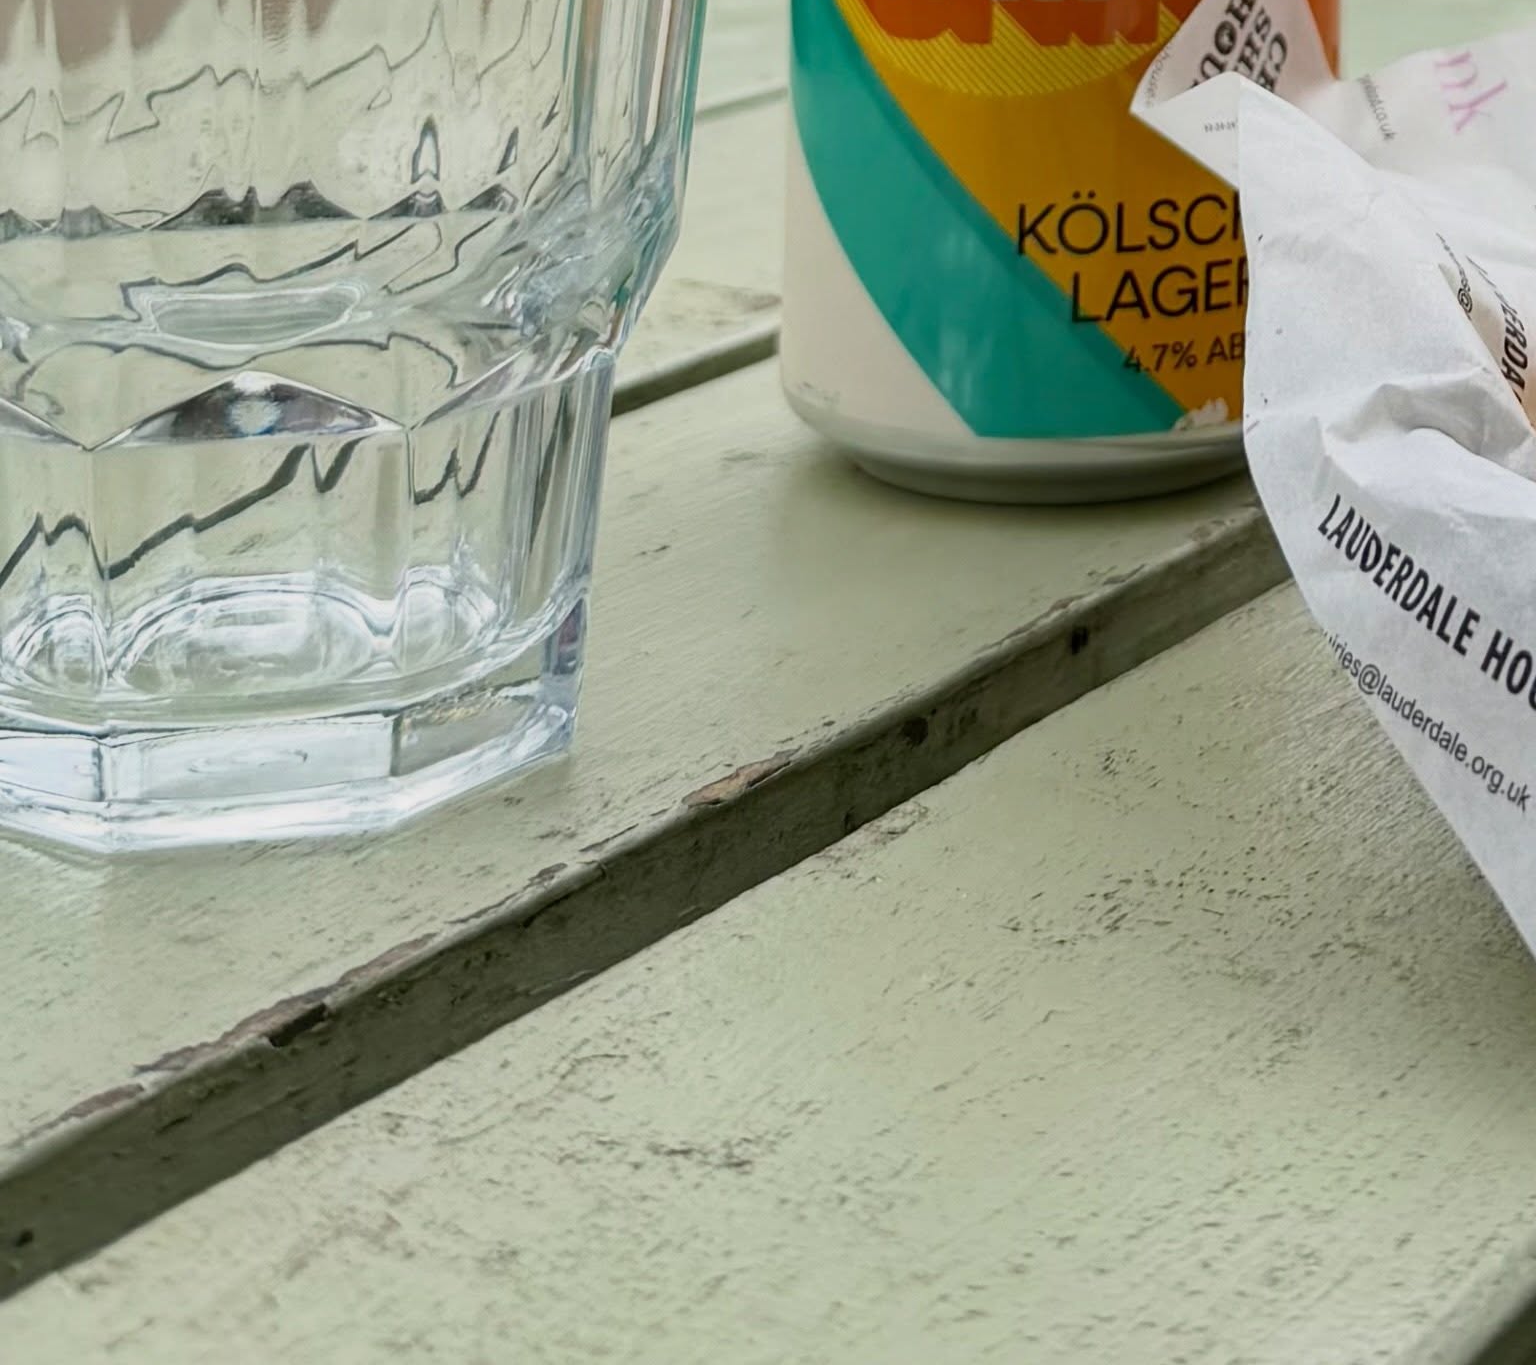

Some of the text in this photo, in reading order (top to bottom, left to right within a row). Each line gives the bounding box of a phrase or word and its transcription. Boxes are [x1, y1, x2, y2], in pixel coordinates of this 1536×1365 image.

[1434, 50, 1508, 135] nk
[1123, 341, 1199, 374] 4.7%
[1317, 493, 1481, 657] LAUDERDALE
